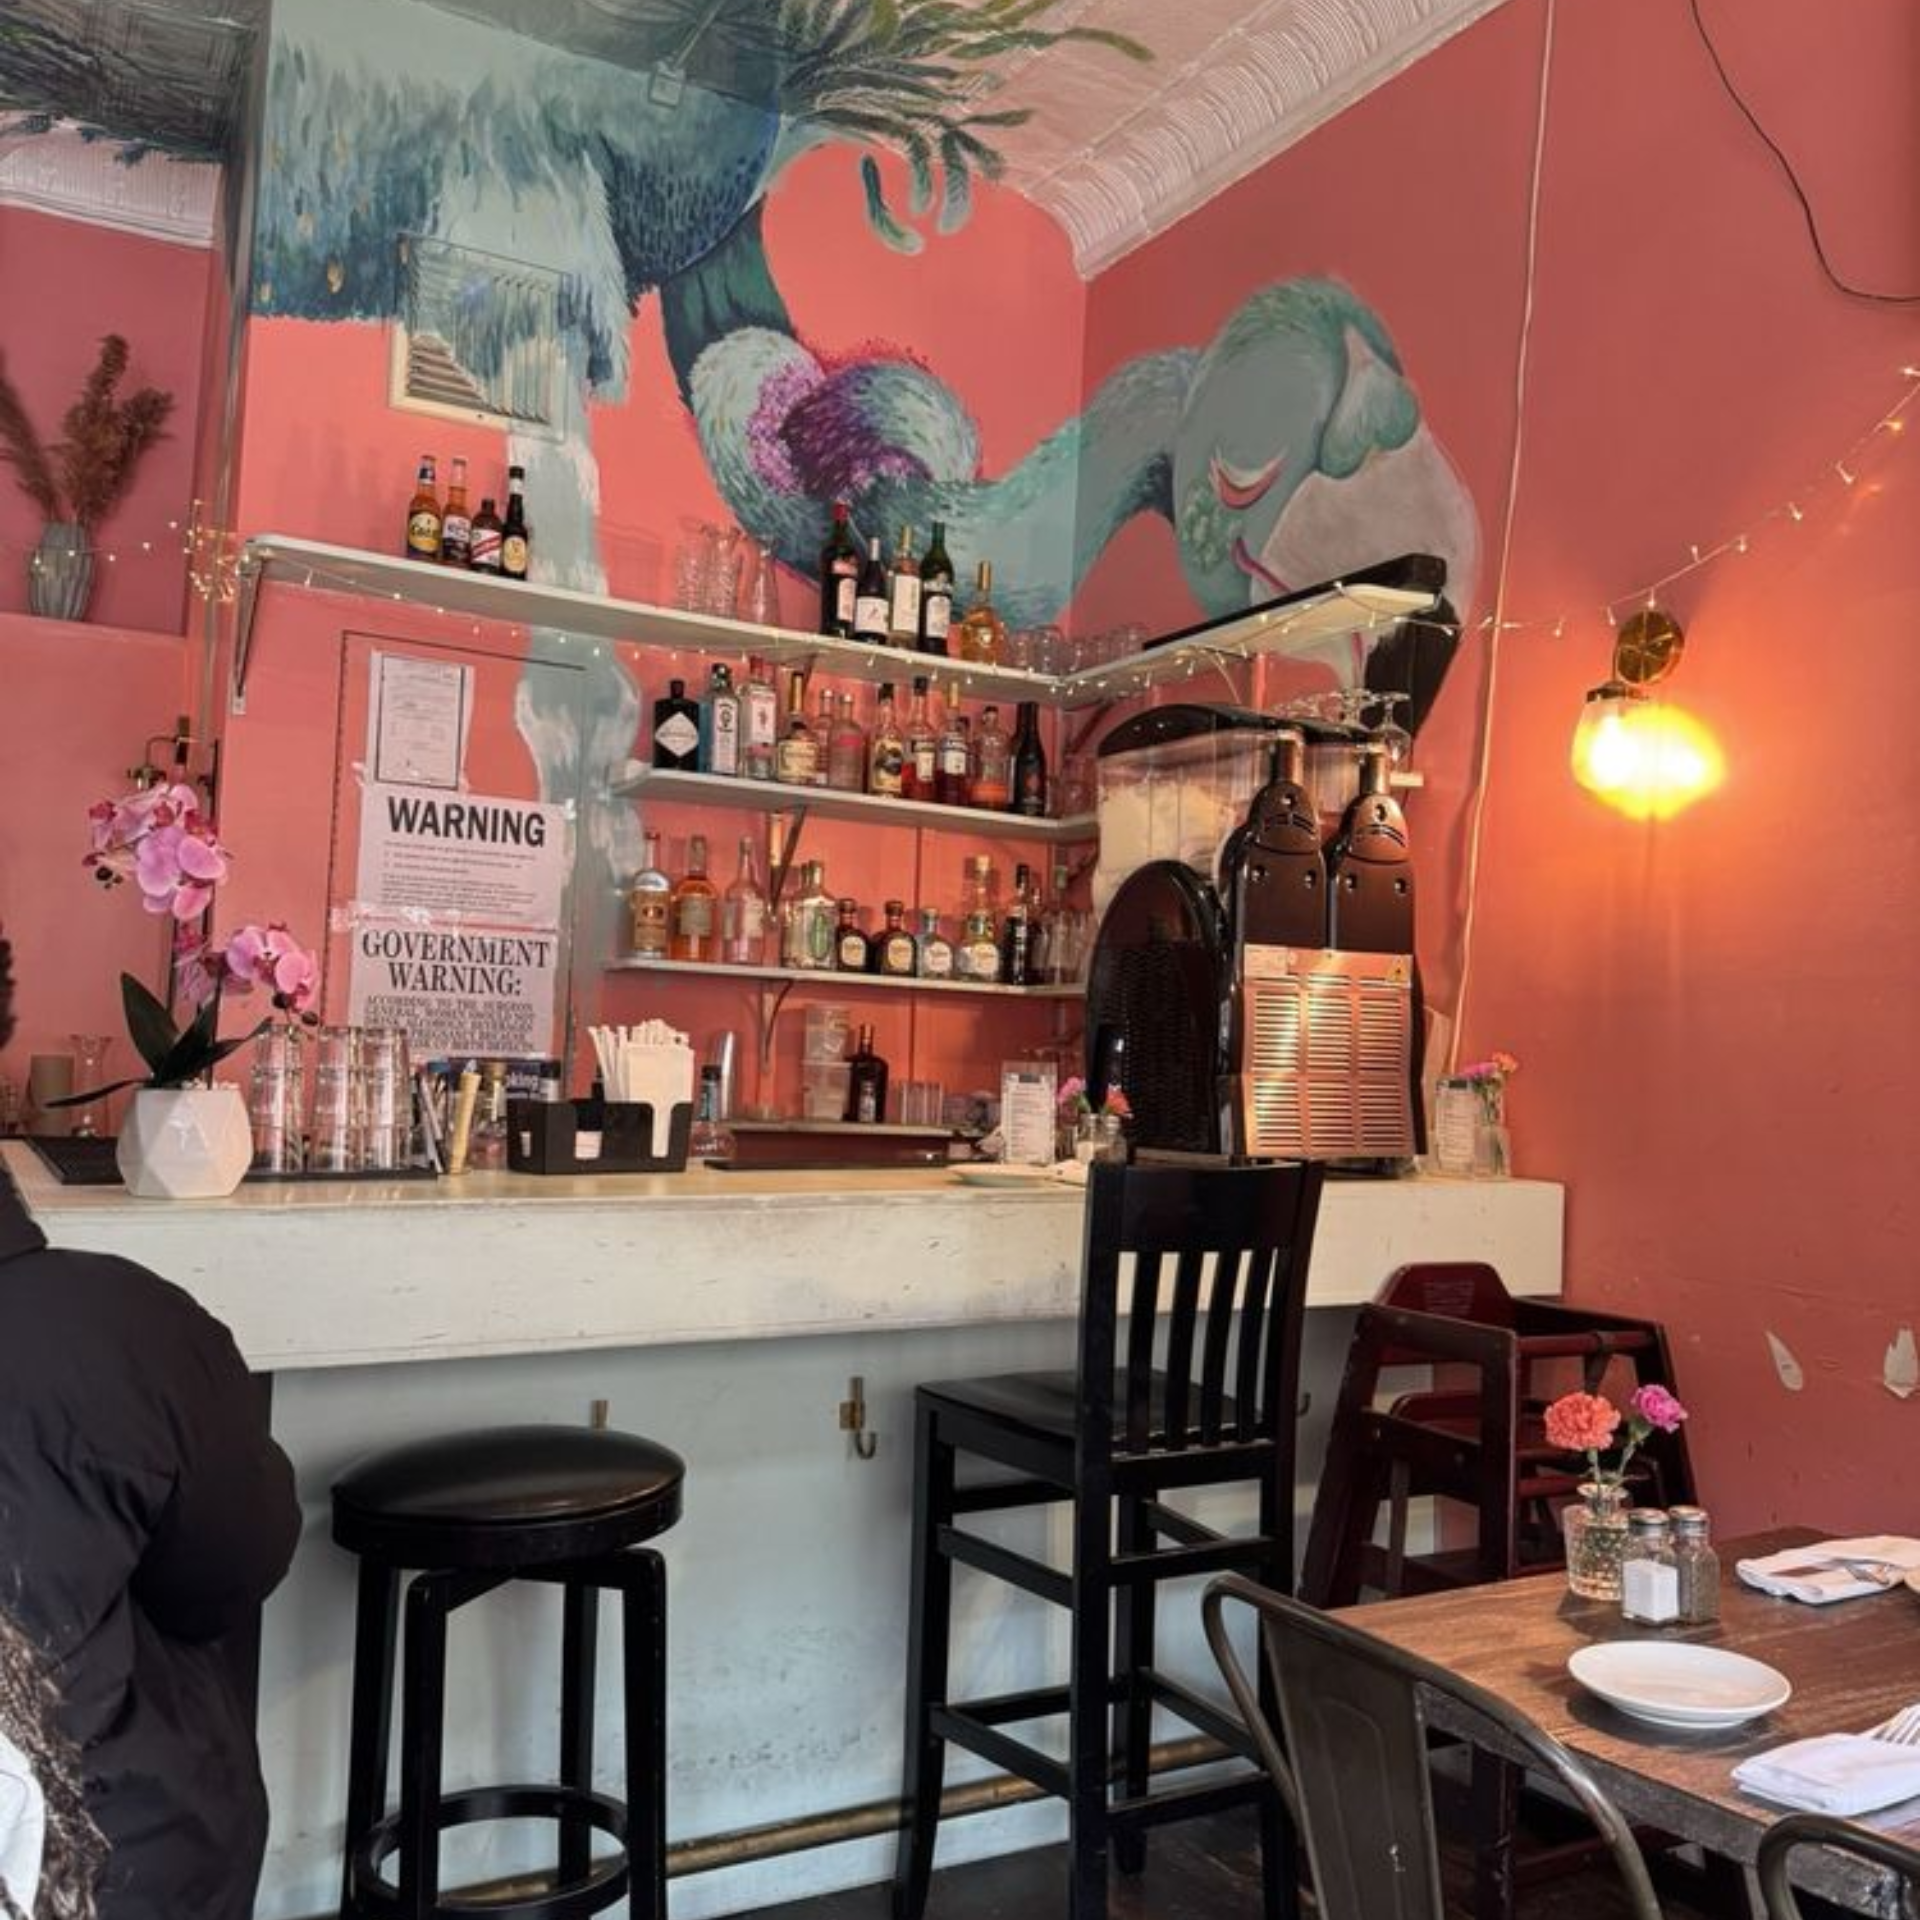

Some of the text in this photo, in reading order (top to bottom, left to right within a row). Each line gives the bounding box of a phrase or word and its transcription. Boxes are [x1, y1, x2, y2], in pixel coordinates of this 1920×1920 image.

[388, 796, 546, 848] WARNING
[363, 930, 549, 968] GOVERNMENT
[388, 962, 521, 996] WARNING:
